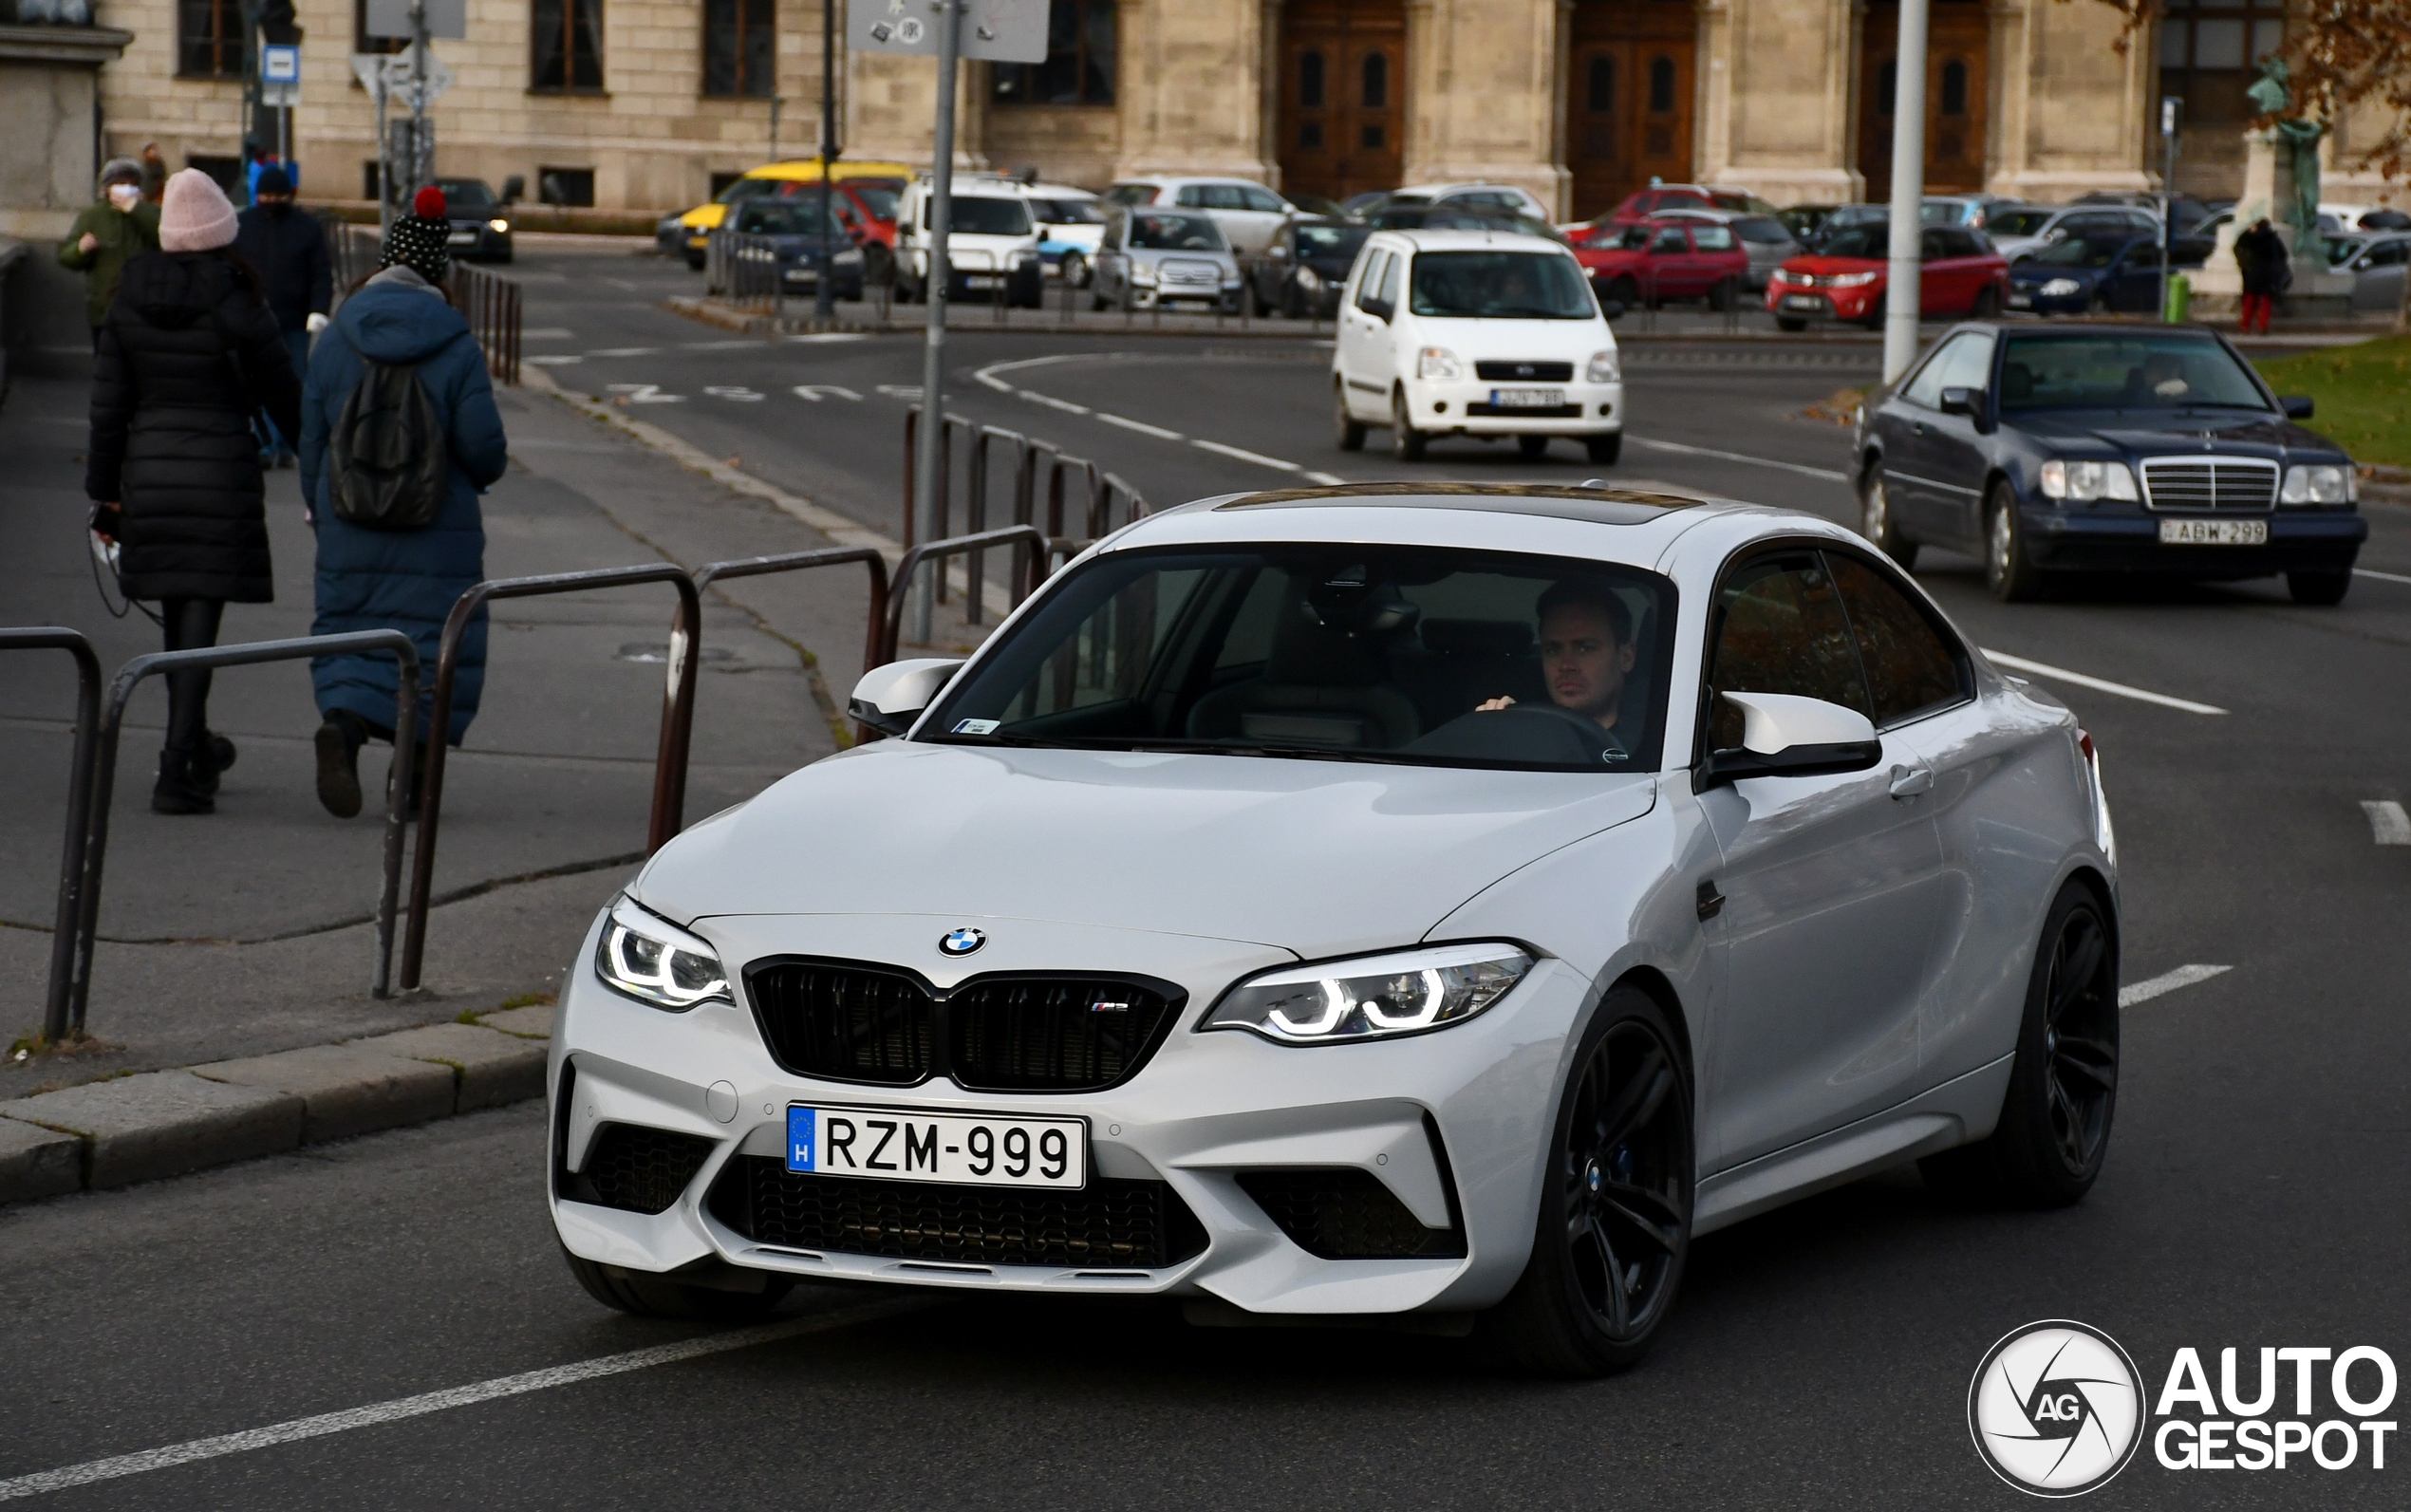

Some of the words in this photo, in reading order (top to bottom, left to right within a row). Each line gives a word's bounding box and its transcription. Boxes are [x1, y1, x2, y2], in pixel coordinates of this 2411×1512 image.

[2178, 522, 2265, 543] ABW-299
[795, 1144, 808, 1162] H
[827, 1117, 1067, 1179] RZM-999
